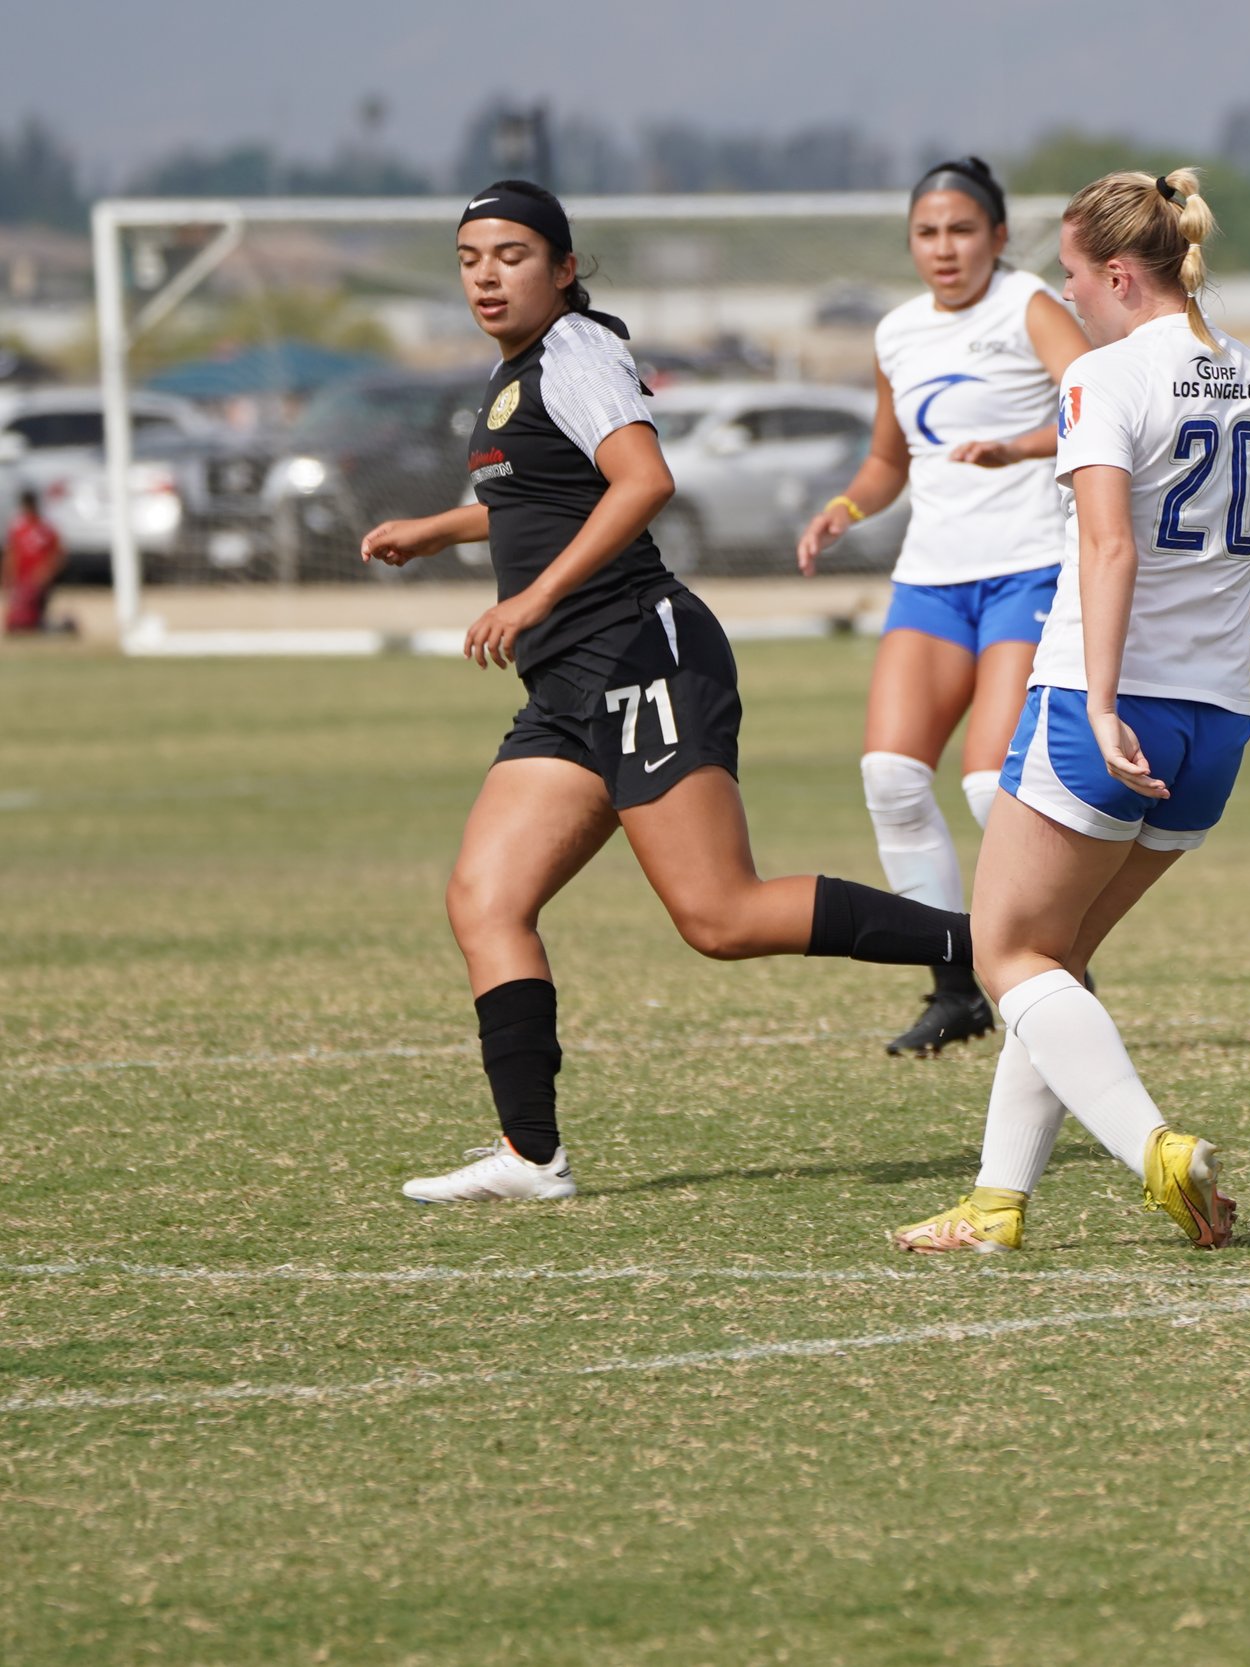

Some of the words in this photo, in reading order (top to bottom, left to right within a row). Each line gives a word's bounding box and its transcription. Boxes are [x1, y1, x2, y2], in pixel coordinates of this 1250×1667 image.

[1197, 365, 1236, 380] SURF
[1173, 381, 1200, 398] LOS
[605, 678, 678, 755] 71
